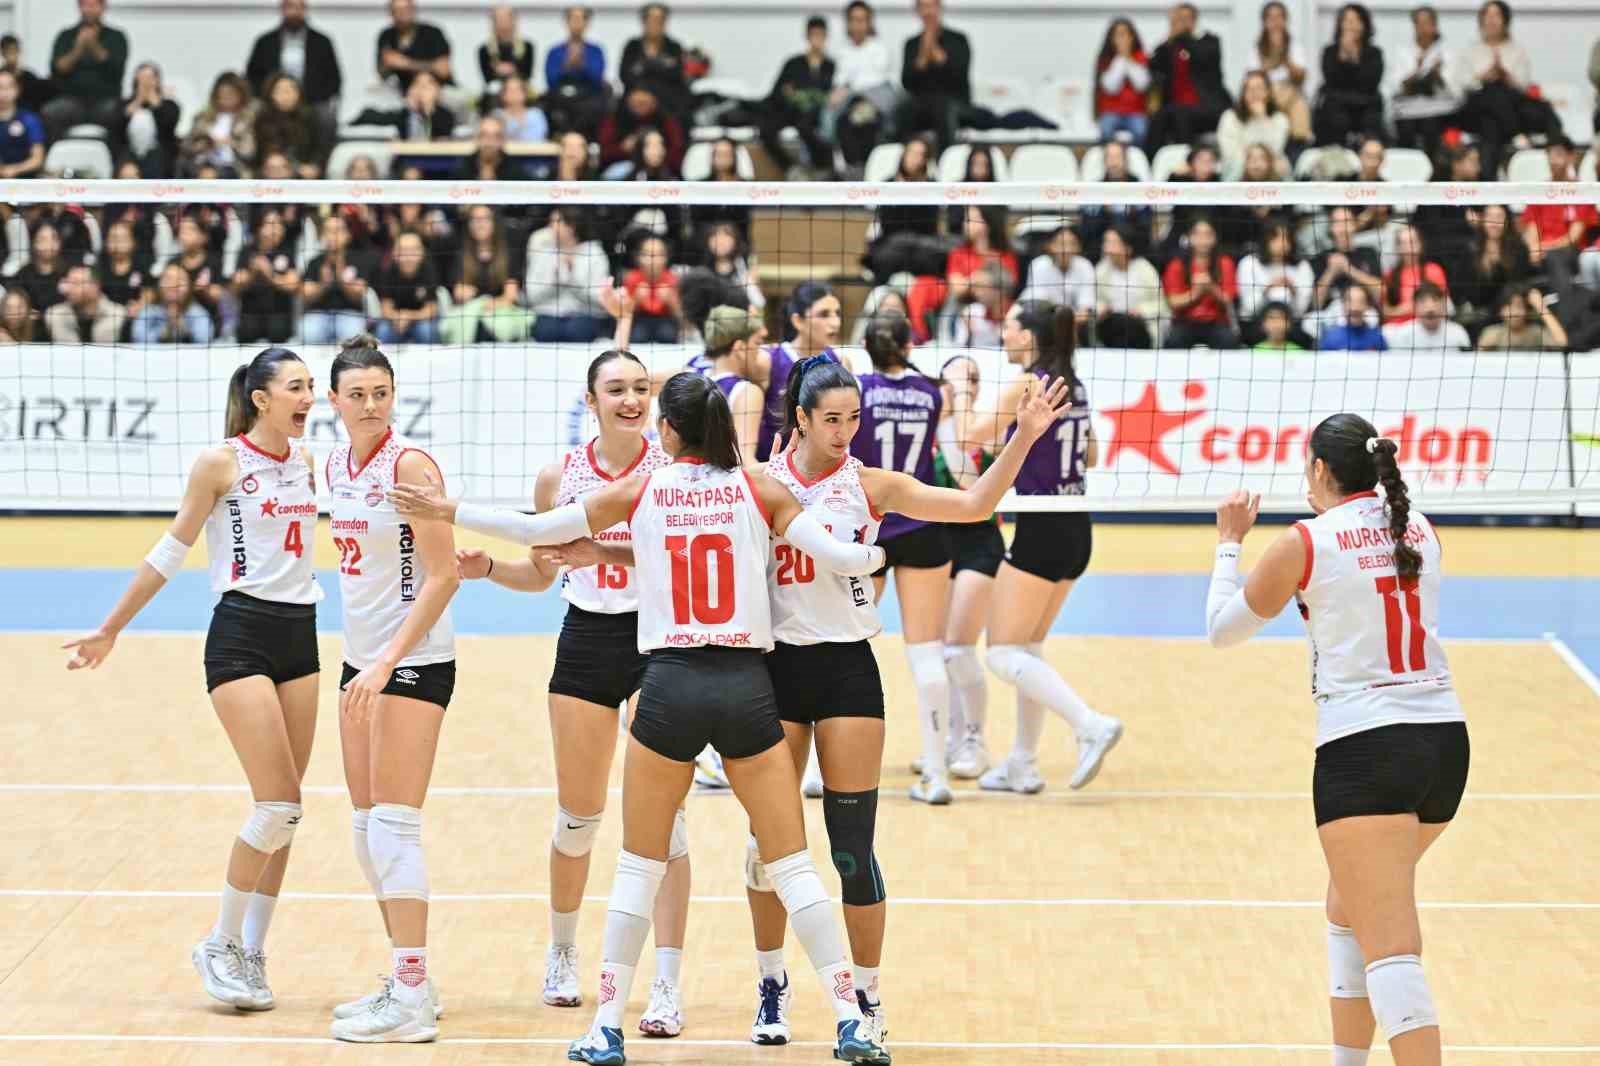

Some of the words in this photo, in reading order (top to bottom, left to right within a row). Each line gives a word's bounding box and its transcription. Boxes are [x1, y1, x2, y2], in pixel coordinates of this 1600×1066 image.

[874, 420, 928, 475] 17
[1200, 415, 1491, 463] cordon
[278, 501, 317, 514] corendo
[284, 521, 304, 558] 4
[333, 537, 362, 576] 22
[592, 530, 632, 541] coren
[665, 533, 735, 625] 10
[775, 544, 815, 586] 20
[1375, 575, 1427, 674] 11
